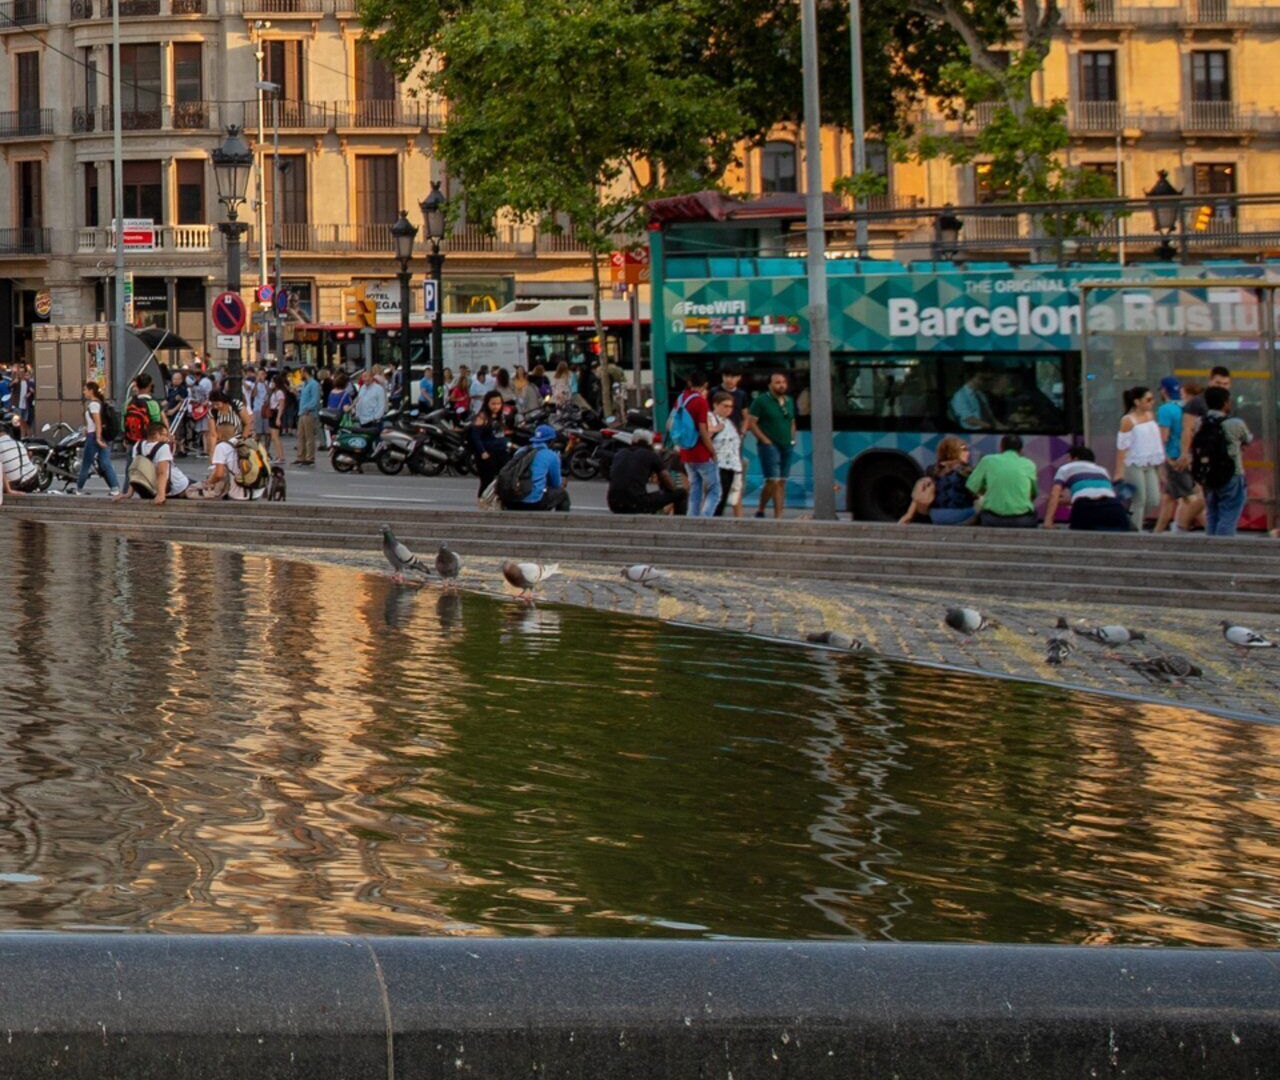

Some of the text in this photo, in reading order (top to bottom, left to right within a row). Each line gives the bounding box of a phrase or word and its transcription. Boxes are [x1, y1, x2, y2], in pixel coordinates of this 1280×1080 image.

[964, 280, 993, 294] THE
[994, 279, 1068, 294] ORIGINAL
[426, 282, 435, 310] P
[375, 300, 402, 310] EGA
[684, 301, 746, 315] FreeWIFI
[888, 291, 1262, 337] Barcelona Bus Tu
